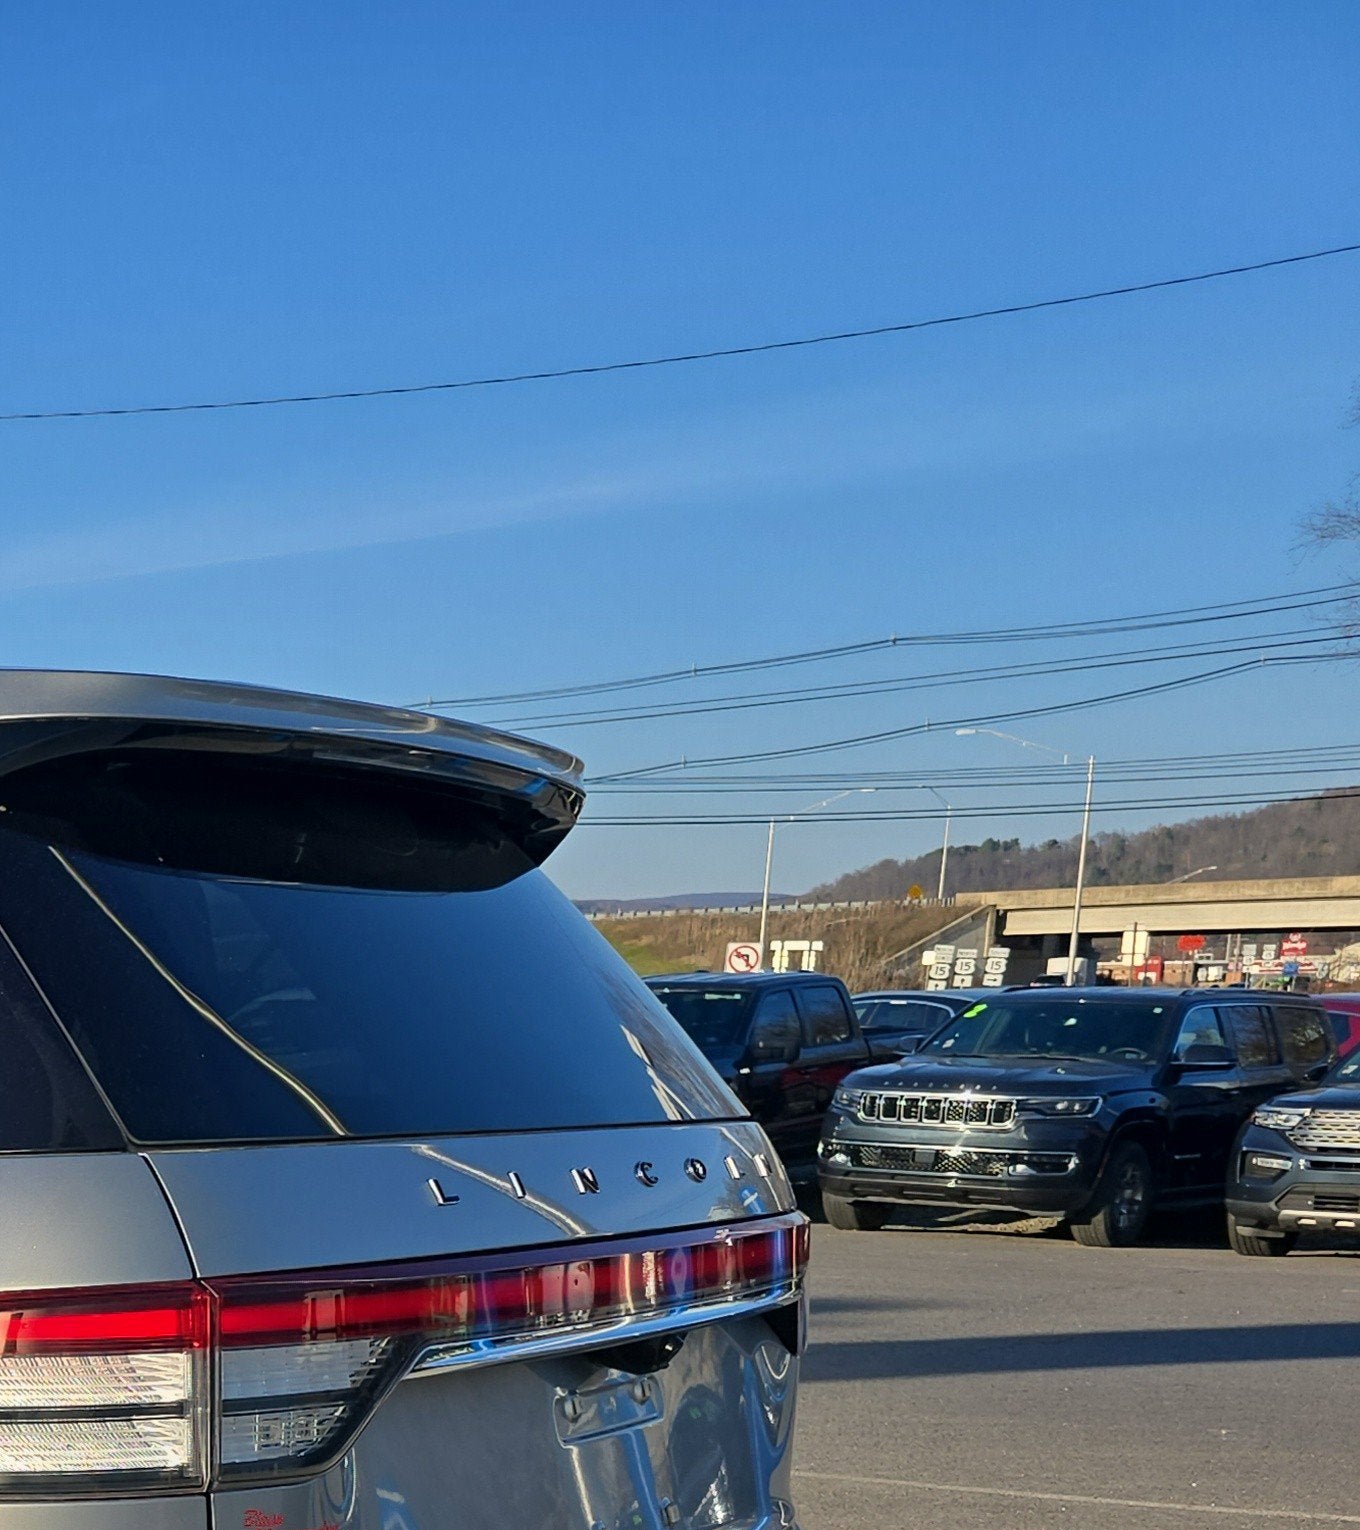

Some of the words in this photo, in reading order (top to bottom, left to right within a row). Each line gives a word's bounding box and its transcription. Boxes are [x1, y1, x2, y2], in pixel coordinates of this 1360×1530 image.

[960, 961, 971, 971] 15
[991, 960, 1001, 970] 15
[935, 966, 946, 976] 15
[427, 1153, 773, 1207] LINCOLN
